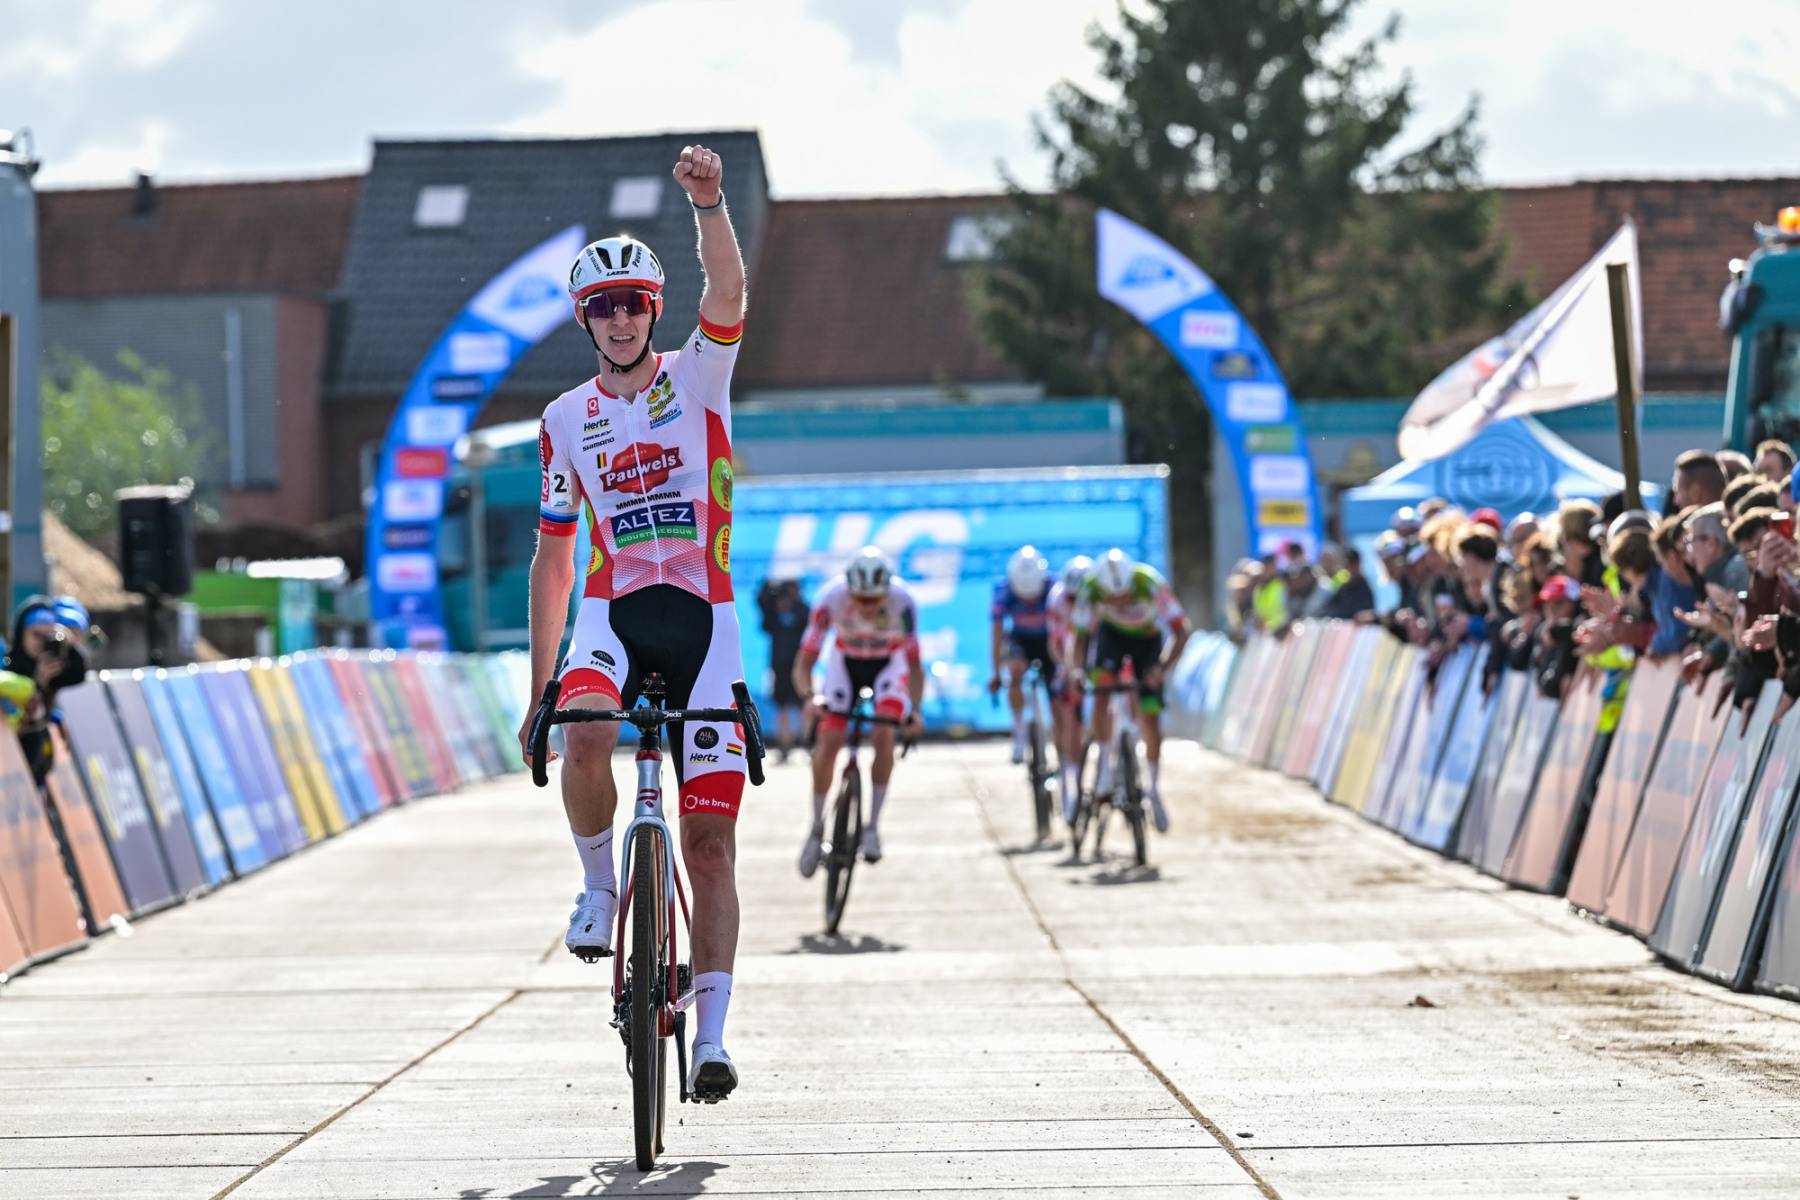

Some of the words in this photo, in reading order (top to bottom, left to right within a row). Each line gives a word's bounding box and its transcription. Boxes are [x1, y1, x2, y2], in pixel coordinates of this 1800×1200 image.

[583, 418, 610, 432] Hertz
[605, 454, 678, 487] Pauwels
[554, 473, 567, 493] 2
[617, 507, 691, 533] ALTEZ
[721, 527, 730, 570] CIBEL
[690, 752, 720, 763] Hertz
[698, 797, 710, 806] de
[711, 798, 730, 809] bree
